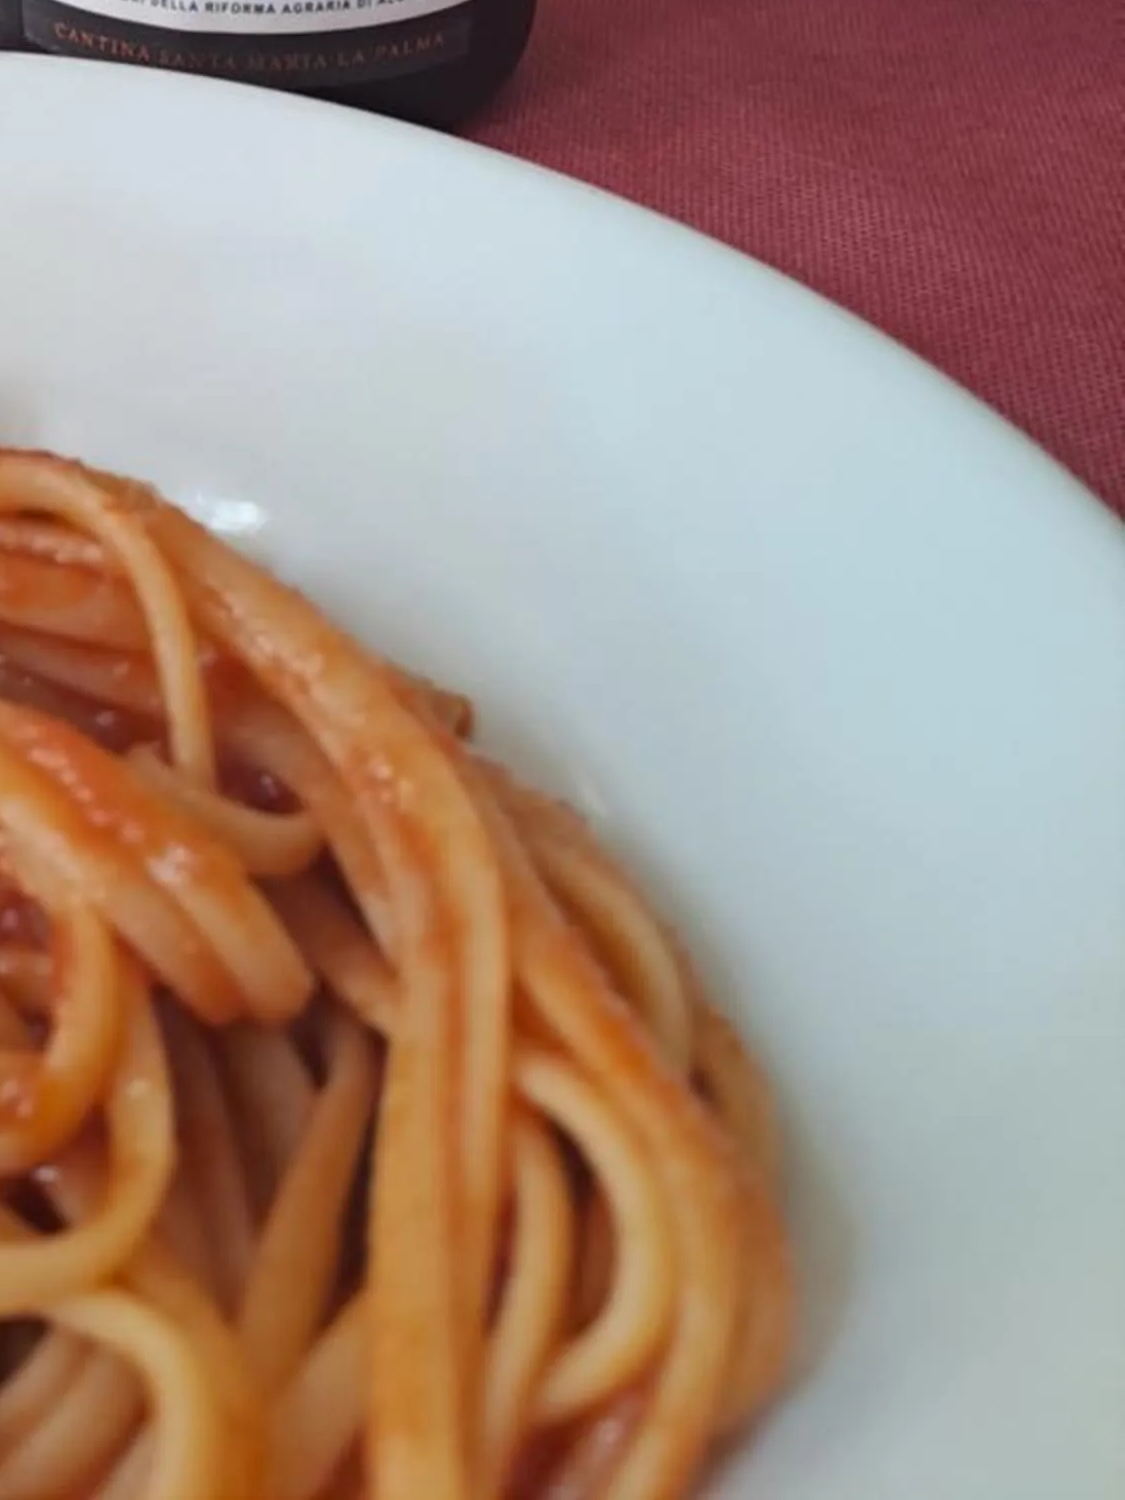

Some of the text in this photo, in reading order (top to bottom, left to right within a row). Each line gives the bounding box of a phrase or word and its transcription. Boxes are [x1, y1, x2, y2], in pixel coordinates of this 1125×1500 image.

[205, 1, 276, 15] RIFORMA
[282, 0, 351, 14] AGRARIA
[53, 20, 151, 63] CANTINA
